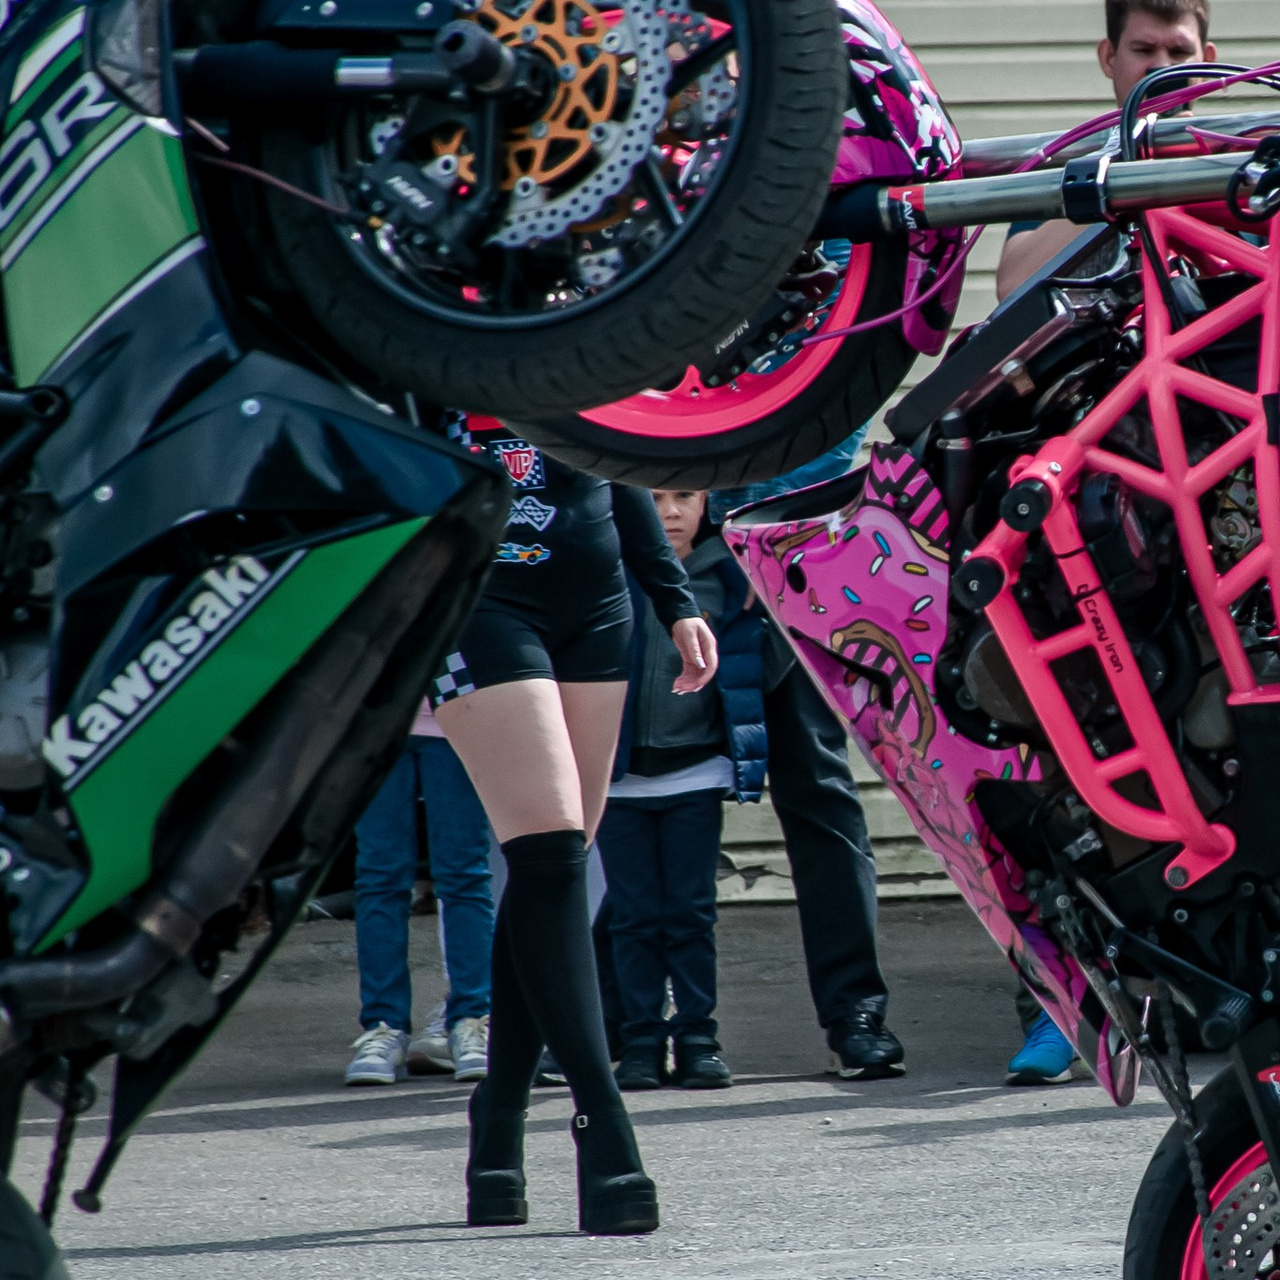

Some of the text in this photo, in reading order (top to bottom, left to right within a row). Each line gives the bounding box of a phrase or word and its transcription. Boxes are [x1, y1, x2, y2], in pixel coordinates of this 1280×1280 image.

[503, 453, 531, 474] VIP
[42, 554, 270, 777] Kawasaki
[1083, 598, 1124, 674] Crazy Iron
